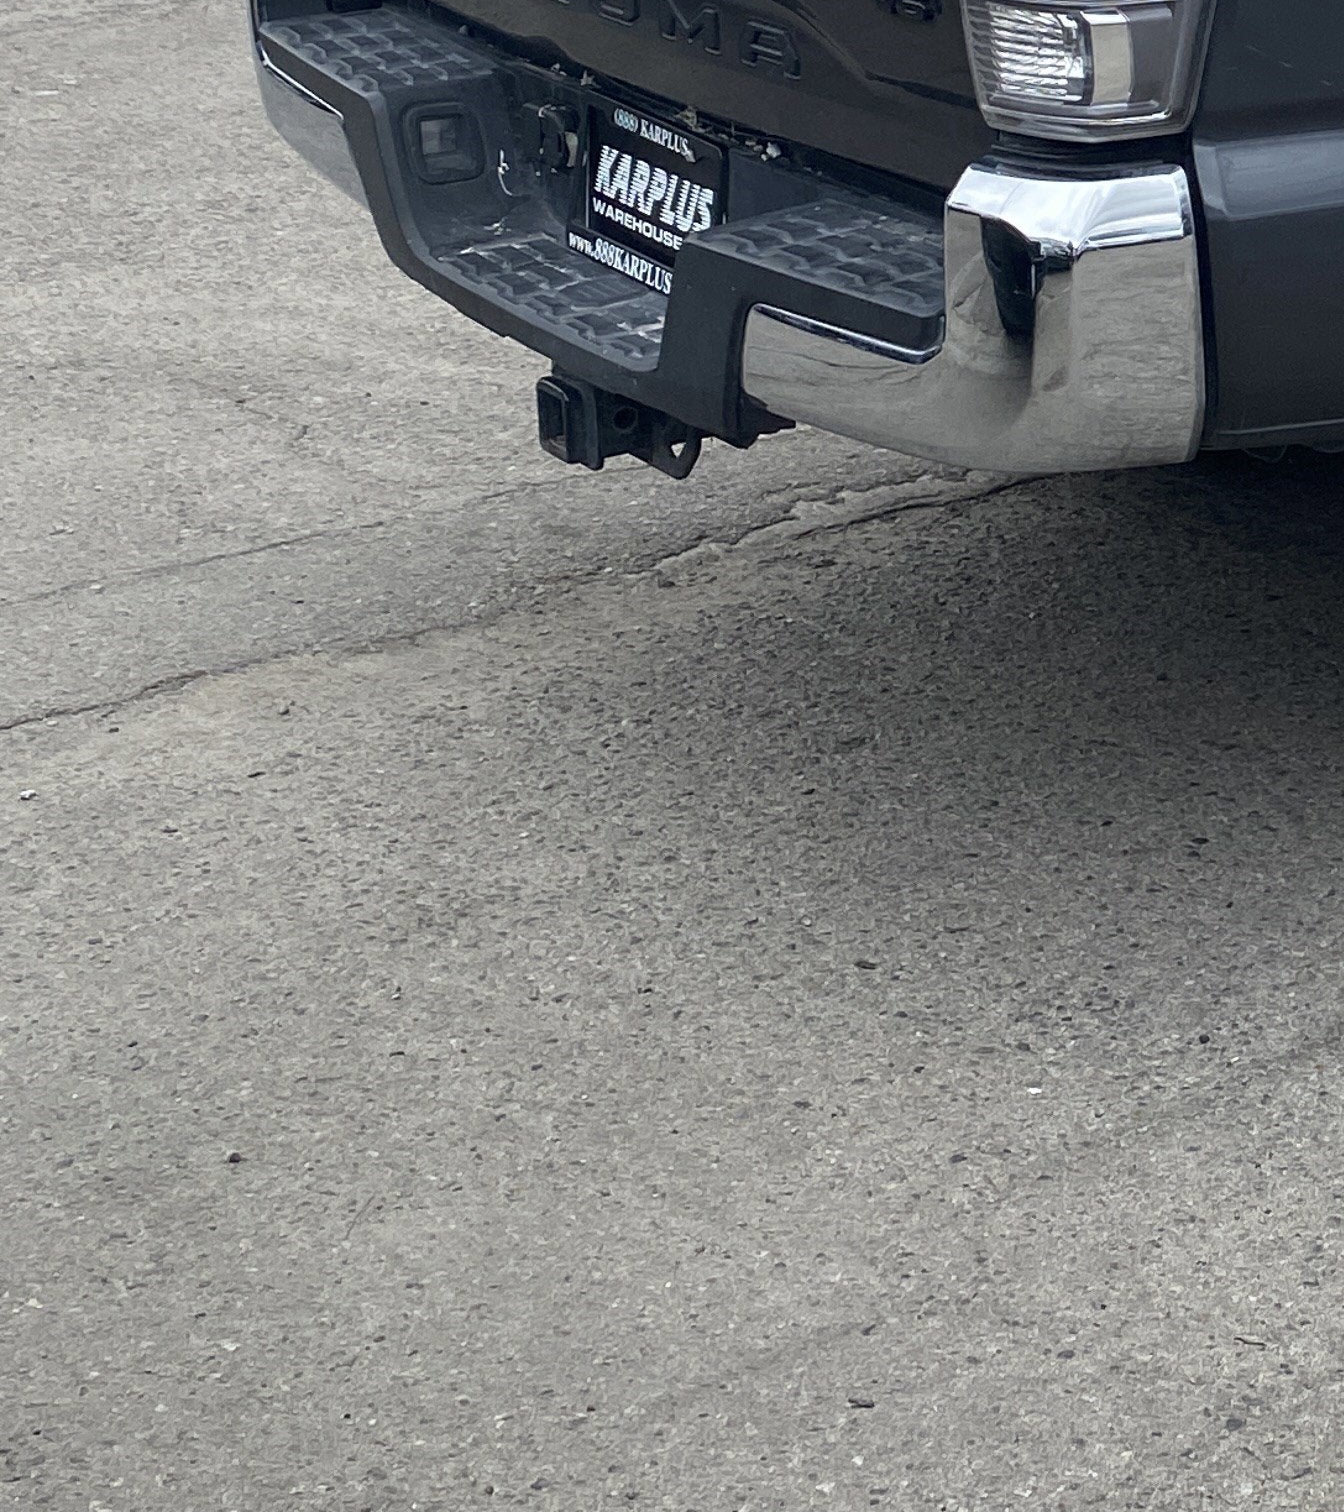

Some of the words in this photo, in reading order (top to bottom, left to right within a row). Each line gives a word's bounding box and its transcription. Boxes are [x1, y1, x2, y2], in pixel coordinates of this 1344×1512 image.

[613, 108, 640, 133] (888)
[640, 119, 692, 156] KARPLUS
[594, 145, 714, 232] KARPLUS
[592, 196, 685, 251] WAREHOUSE
